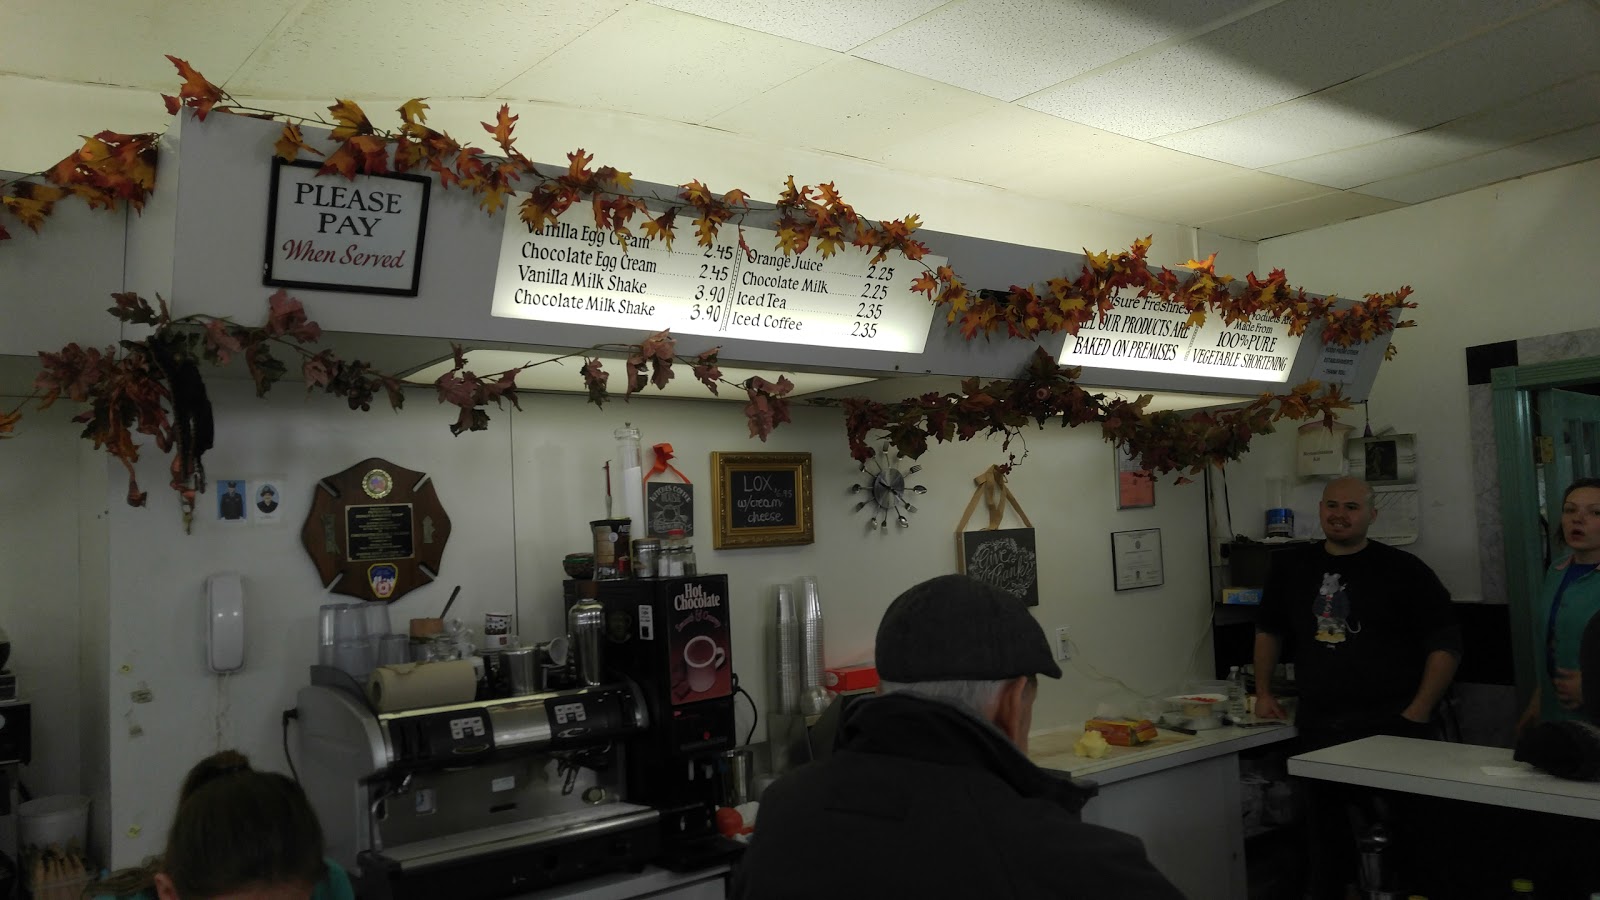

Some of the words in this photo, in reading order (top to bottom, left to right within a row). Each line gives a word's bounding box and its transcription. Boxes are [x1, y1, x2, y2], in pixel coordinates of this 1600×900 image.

[294, 182, 402, 214] PLEASE
[317, 212, 382, 237] PAY
[282, 239, 336, 263] When
[339, 244, 406, 269] Served
[581, 225, 605, 247] Egg
[609, 230, 651, 249] Cream
[703, 244, 734, 260] 2.45
[522, 242, 593, 265] Chocolate
[595, 251, 617, 272] Egg
[620, 253, 657, 273] Cream
[699, 264, 729, 281] 2.45
[747, 248, 793, 271] Orange
[791, 256, 823, 272] Juice
[866, 265, 895, 281] 2.25
[518, 264, 567, 286] Vanilla
[571, 271, 604, 289] Milk
[607, 275, 647, 294] Shake
[694, 284, 725, 303] 3.90
[742, 271, 799, 291] Chocolate
[801, 278, 829, 294] Milk
[860, 283, 889, 300] 2.25
[514, 288, 583, 309] Chocolate
[586, 296, 616, 312] Milk
[618, 299, 655, 316] Shake
[690, 304, 721, 322] 3.90
[736, 291, 765, 307] Iced
[767, 293, 787, 310] Tea
[856, 302, 884, 320] 2.35
[1251, 311, 1281, 323] roducts
[732, 311, 761, 327] Iced
[764, 314, 803, 331] Coffee
[851, 321, 879, 339] 2.35
[1098, 313, 1122, 332] OUR
[1121, 315, 1172, 337] PRODUCTS
[1233, 320, 1255, 332] Made
[1255, 323, 1274, 334] From
[1072, 336, 1112, 356] BAKED
[1112, 339, 1131, 358] ON
[1128, 340, 1179, 361] PREMISES
[1247, 334, 1278, 353] PURE
[1192, 348, 1241, 367] VEGETABLE
[1240, 353, 1289, 371] SHORTENING
[743, 473, 773, 492] LOX
[747, 511, 783, 523] cheese
[673, 591, 721, 611] Chocolate
[683, 582, 703, 598] Hot
